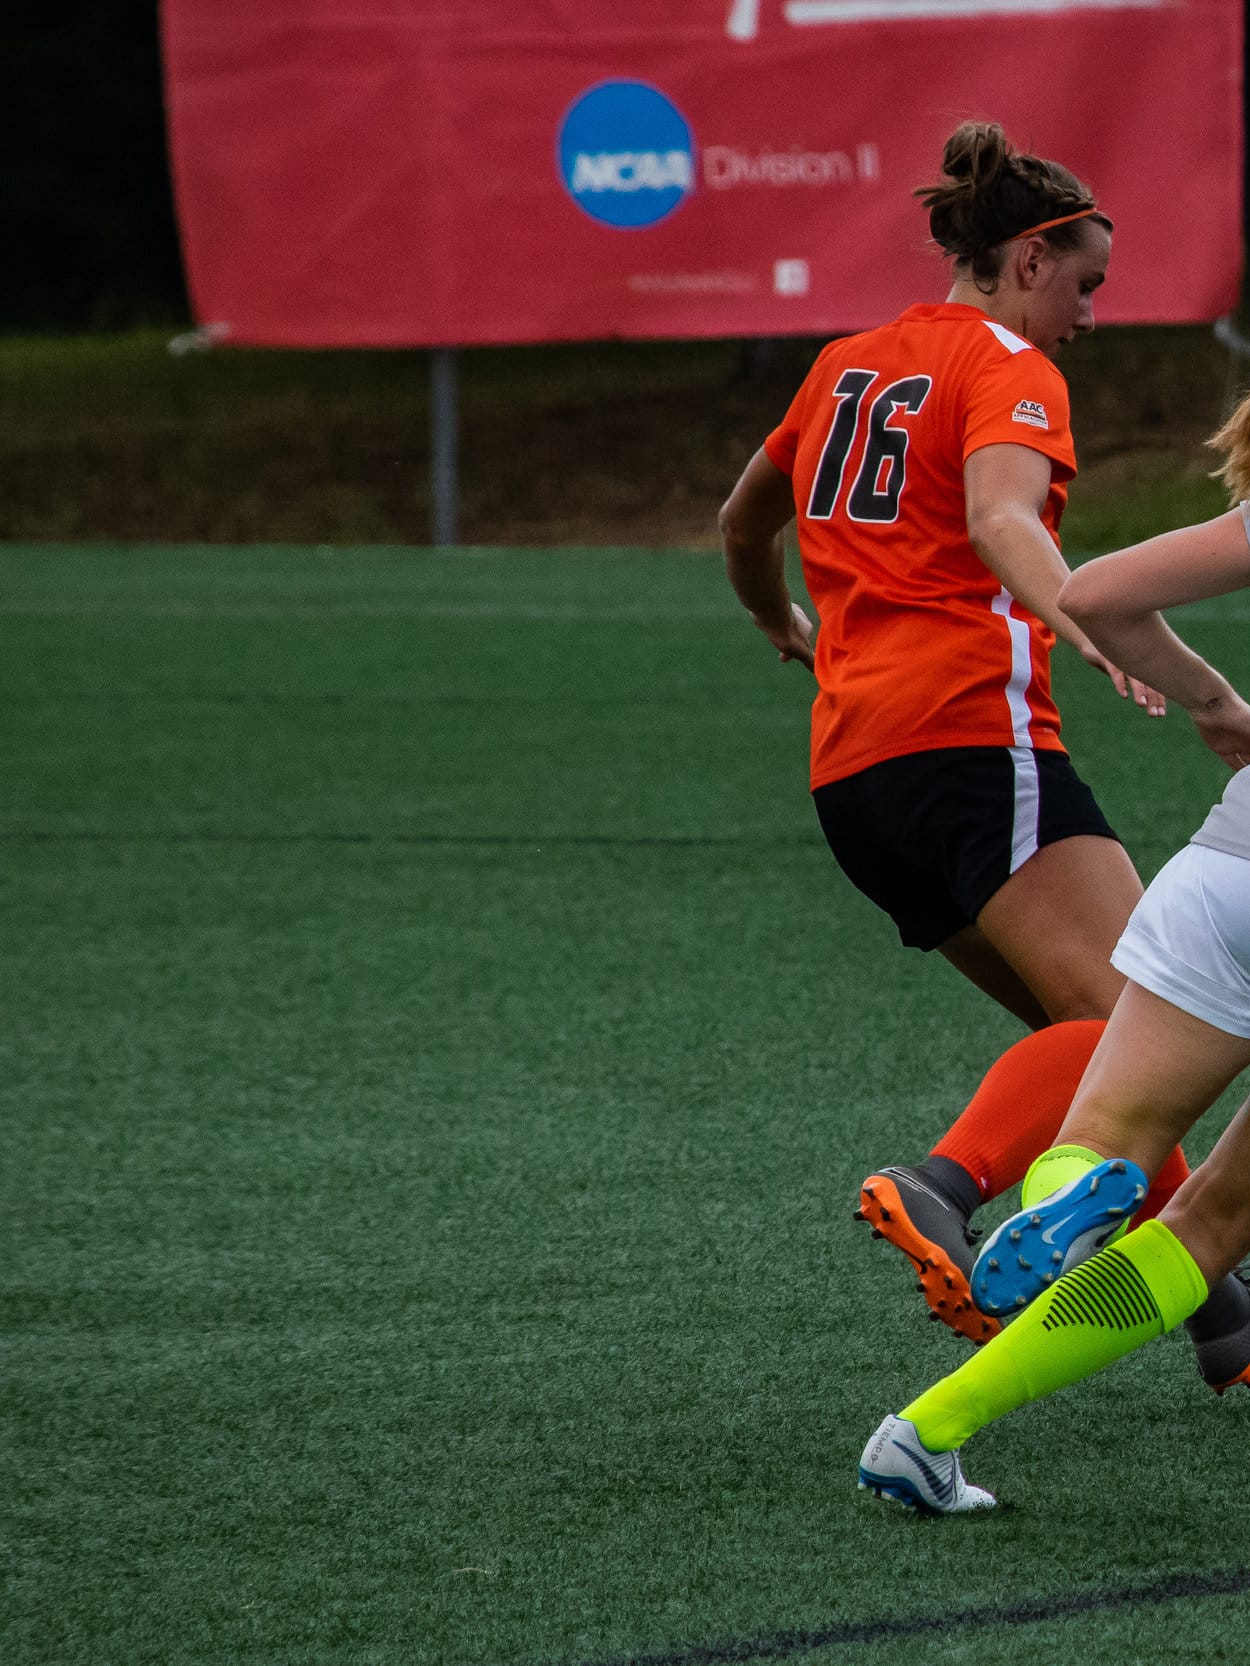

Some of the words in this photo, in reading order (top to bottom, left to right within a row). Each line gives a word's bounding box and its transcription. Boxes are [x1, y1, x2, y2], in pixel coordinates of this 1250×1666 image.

[572, 151, 691, 192] NCAA
[703, 144, 851, 190] Division
[1020, 400, 1043, 414] AAC
[806, 369, 932, 524] 16
[870, 1423, 896, 1463] TIEMPO
